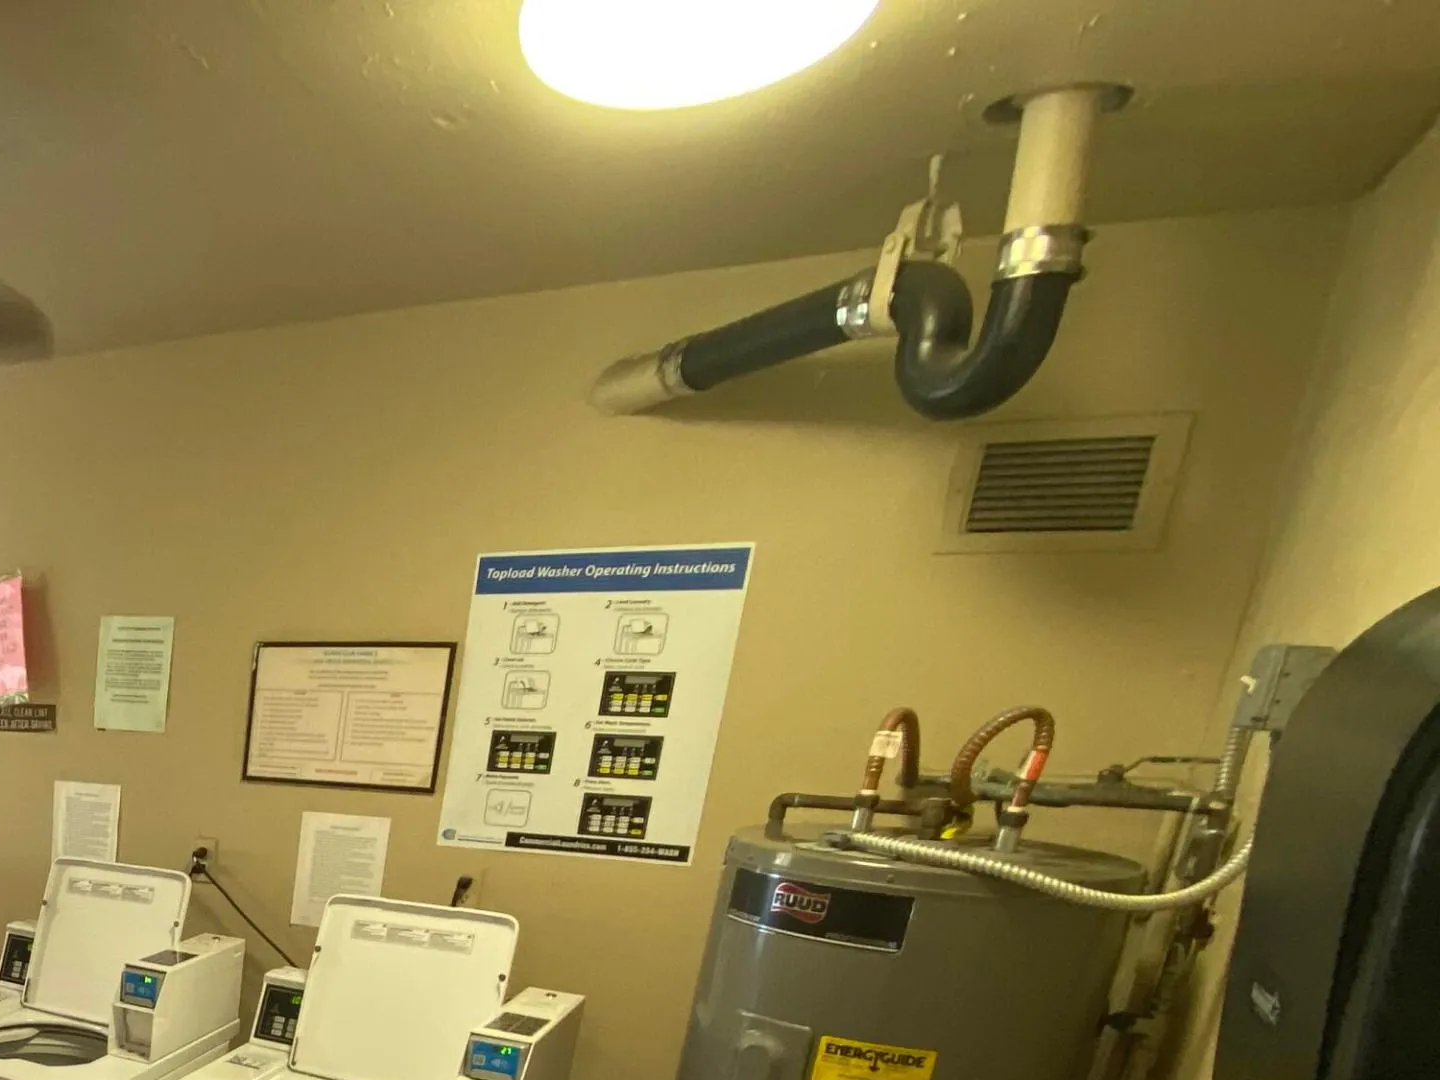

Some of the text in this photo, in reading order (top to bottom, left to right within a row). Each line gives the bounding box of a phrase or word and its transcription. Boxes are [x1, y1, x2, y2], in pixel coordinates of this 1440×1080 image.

[487, 561, 736, 581] Topload Washer Operating Instructions
[773, 892, 826, 913] RUUD
[825, 1043, 926, 1071] ENERGYGUIDE
